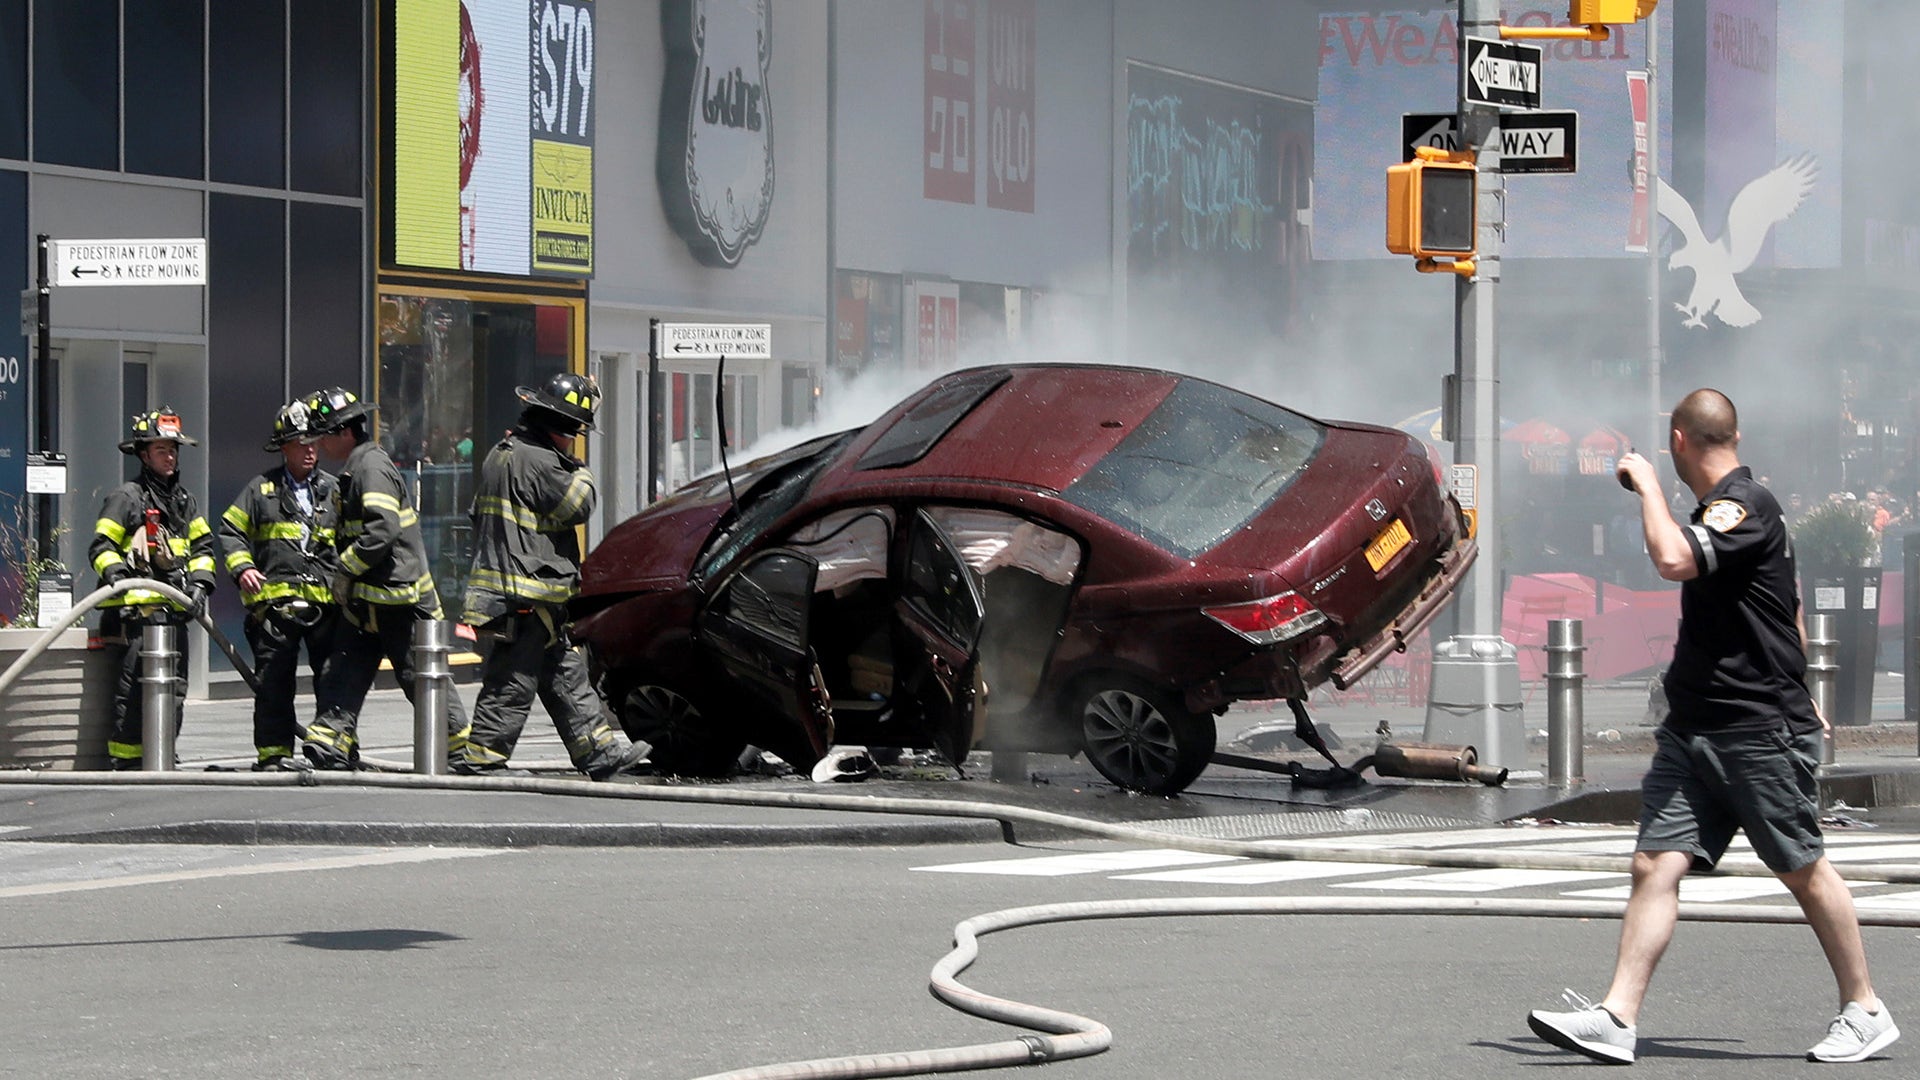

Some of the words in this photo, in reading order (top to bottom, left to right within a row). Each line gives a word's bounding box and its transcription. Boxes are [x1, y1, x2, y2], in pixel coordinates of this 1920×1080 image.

[993, 12, 1027, 91] UNI
[540, 0, 593, 137] $79
[1478, 60, 1499, 85] ONE
[1509, 63, 1532, 89] WAY
[993, 106, 1030, 193] QLO
[1429, 133, 1458, 151] ON
[1501, 132, 1553, 155] WAY
[536, 187, 590, 224] INVICTA
[69, 246, 135, 260] PEDESTRIAN
[139, 246, 168, 259] FLOW
[171, 245, 199, 259] ZONE
[128, 264, 154, 278] KEEP
[158, 264, 200, 278] MOVING
[672, 327, 720, 340] PEDESTRIAN
[722, 328, 743, 340] FLOW
[745, 329, 766, 340] ZONE
[714, 343, 734, 353] KEEP
[736, 343, 766, 354] MOVING
